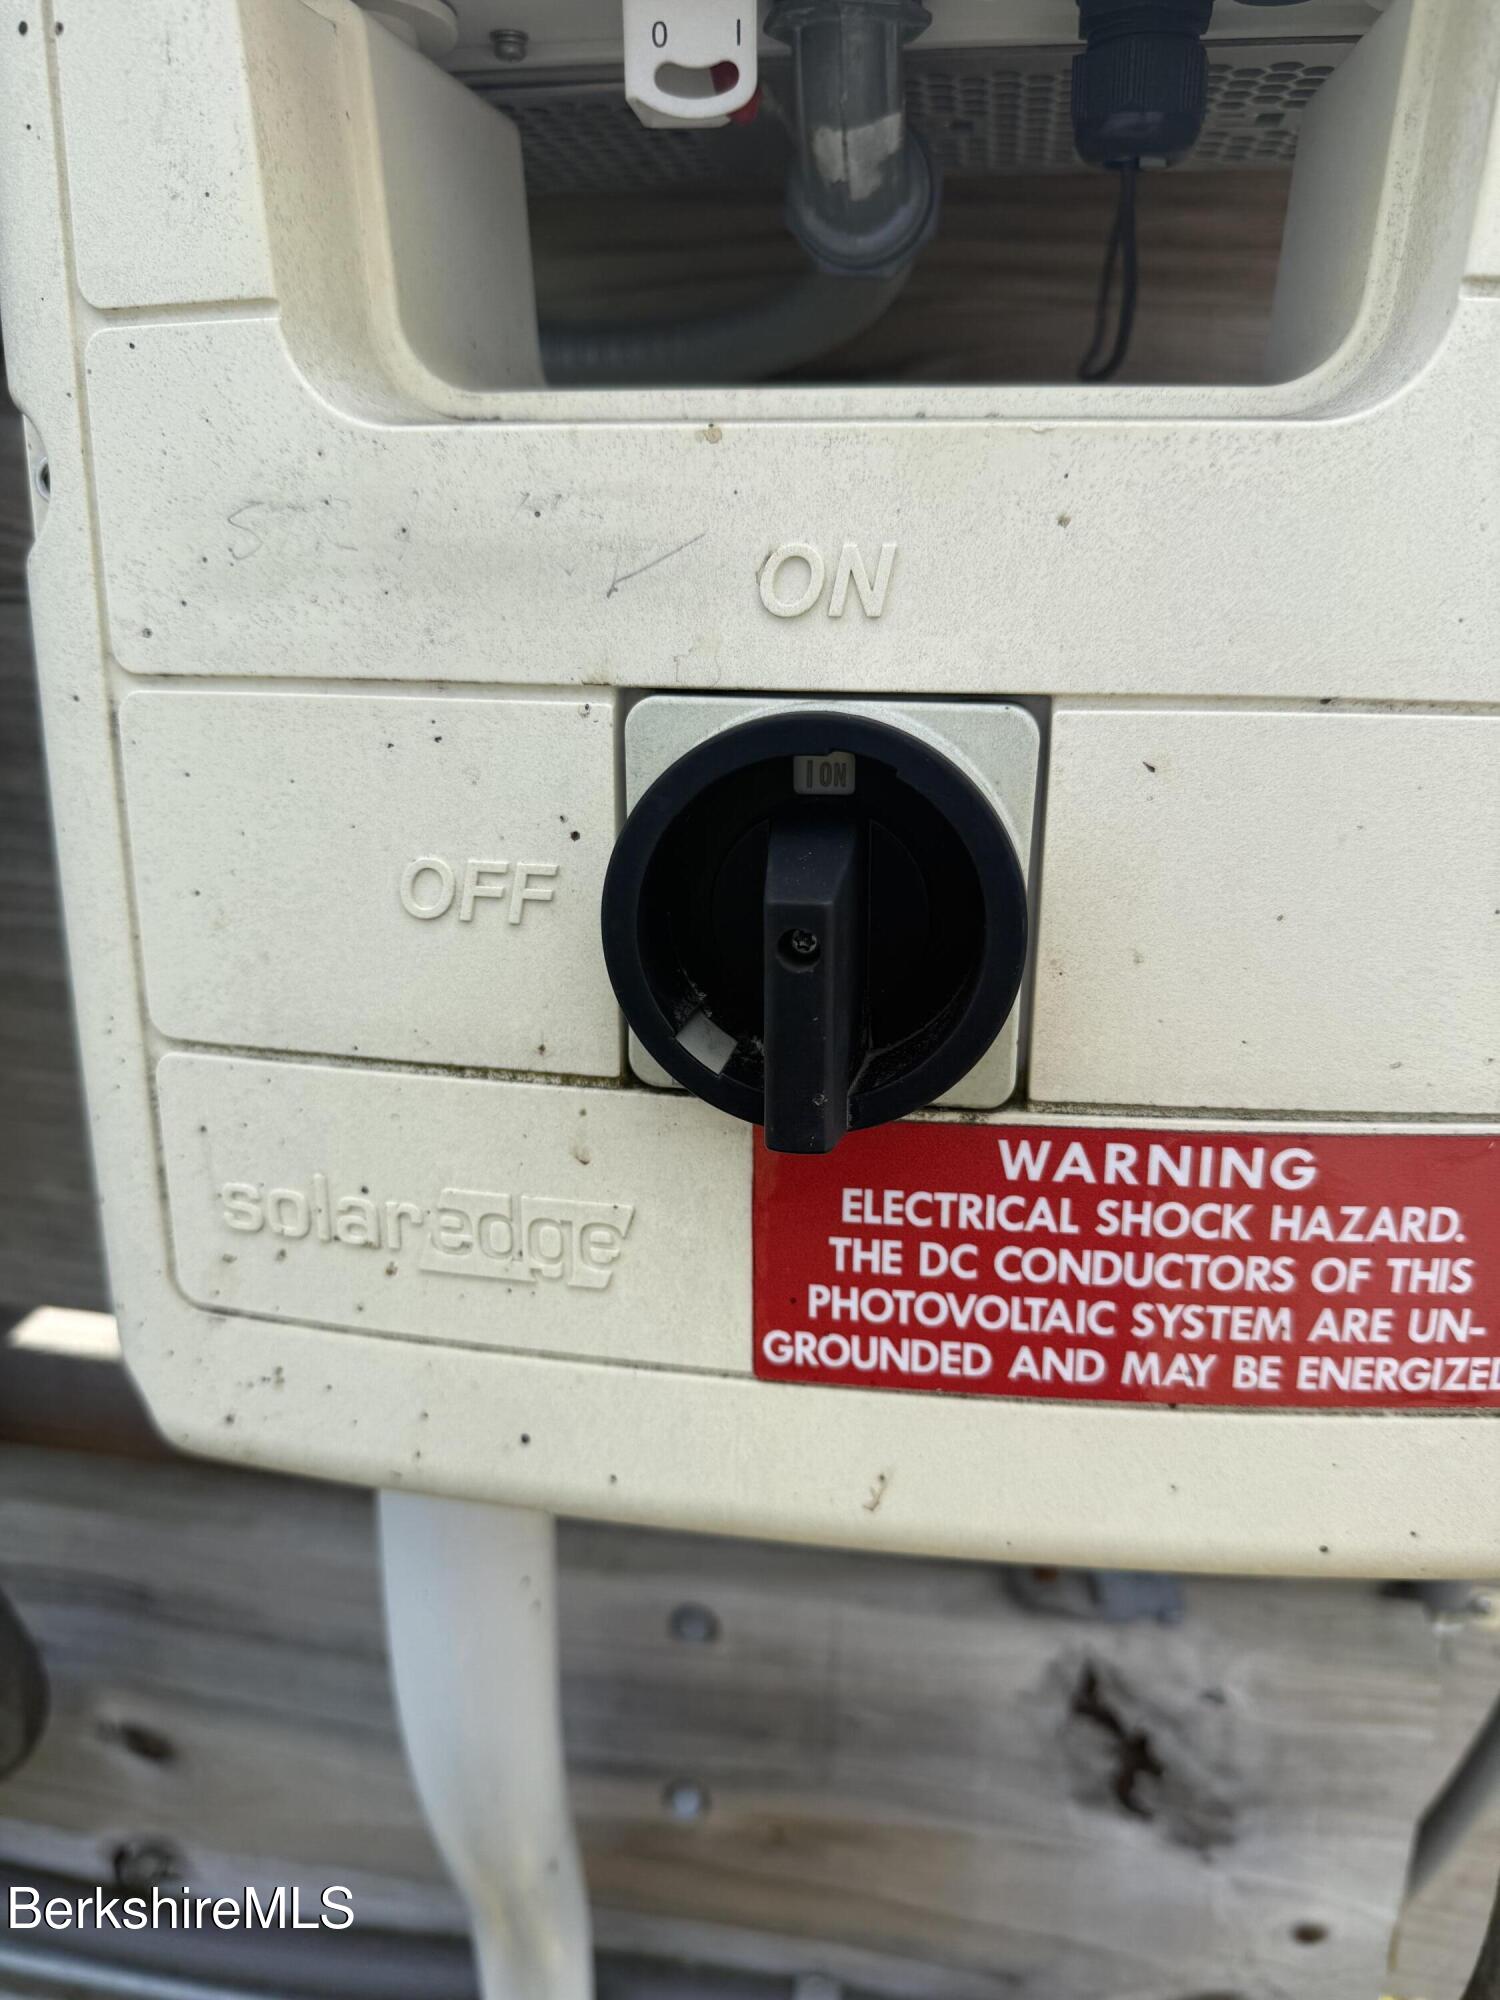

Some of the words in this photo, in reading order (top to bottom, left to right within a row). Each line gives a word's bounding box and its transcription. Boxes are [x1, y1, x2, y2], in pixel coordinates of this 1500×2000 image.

[759, 542, 897, 619] ON
[820, 762, 847, 787] ON
[400, 857, 560, 926] OFF
[998, 1139, 1318, 1191] WARNING
[221, 1174, 632, 1284] solaredge
[842, 1188, 1080, 1234] ELECTRICAL
[1095, 1199, 1254, 1241] SHOCK
[1269, 1204, 1467, 1244] HAZARD.
[828, 1236, 903, 1275] THE
[919, 1241, 978, 1280] DC
[993, 1245, 1297, 1294] CONDUCTORS
[1310, 1257, 1374, 1295] OF
[1386, 1257, 1476, 1295] THIS
[808, 1284, 1117, 1337] PHOTOVOLTAIC
[1130, 1302, 1293, 1343] SYSTEM
[1306, 1307, 1396, 1344] ARE
[1407, 1307, 1487, 1345] UN-
[762, 1329, 994, 1377] GROUNDED
[1008, 1345, 1106, 1384] AND
[1121, 1351, 1218, 1389] MAY
[1232, 1354, 1283, 1391] BE
